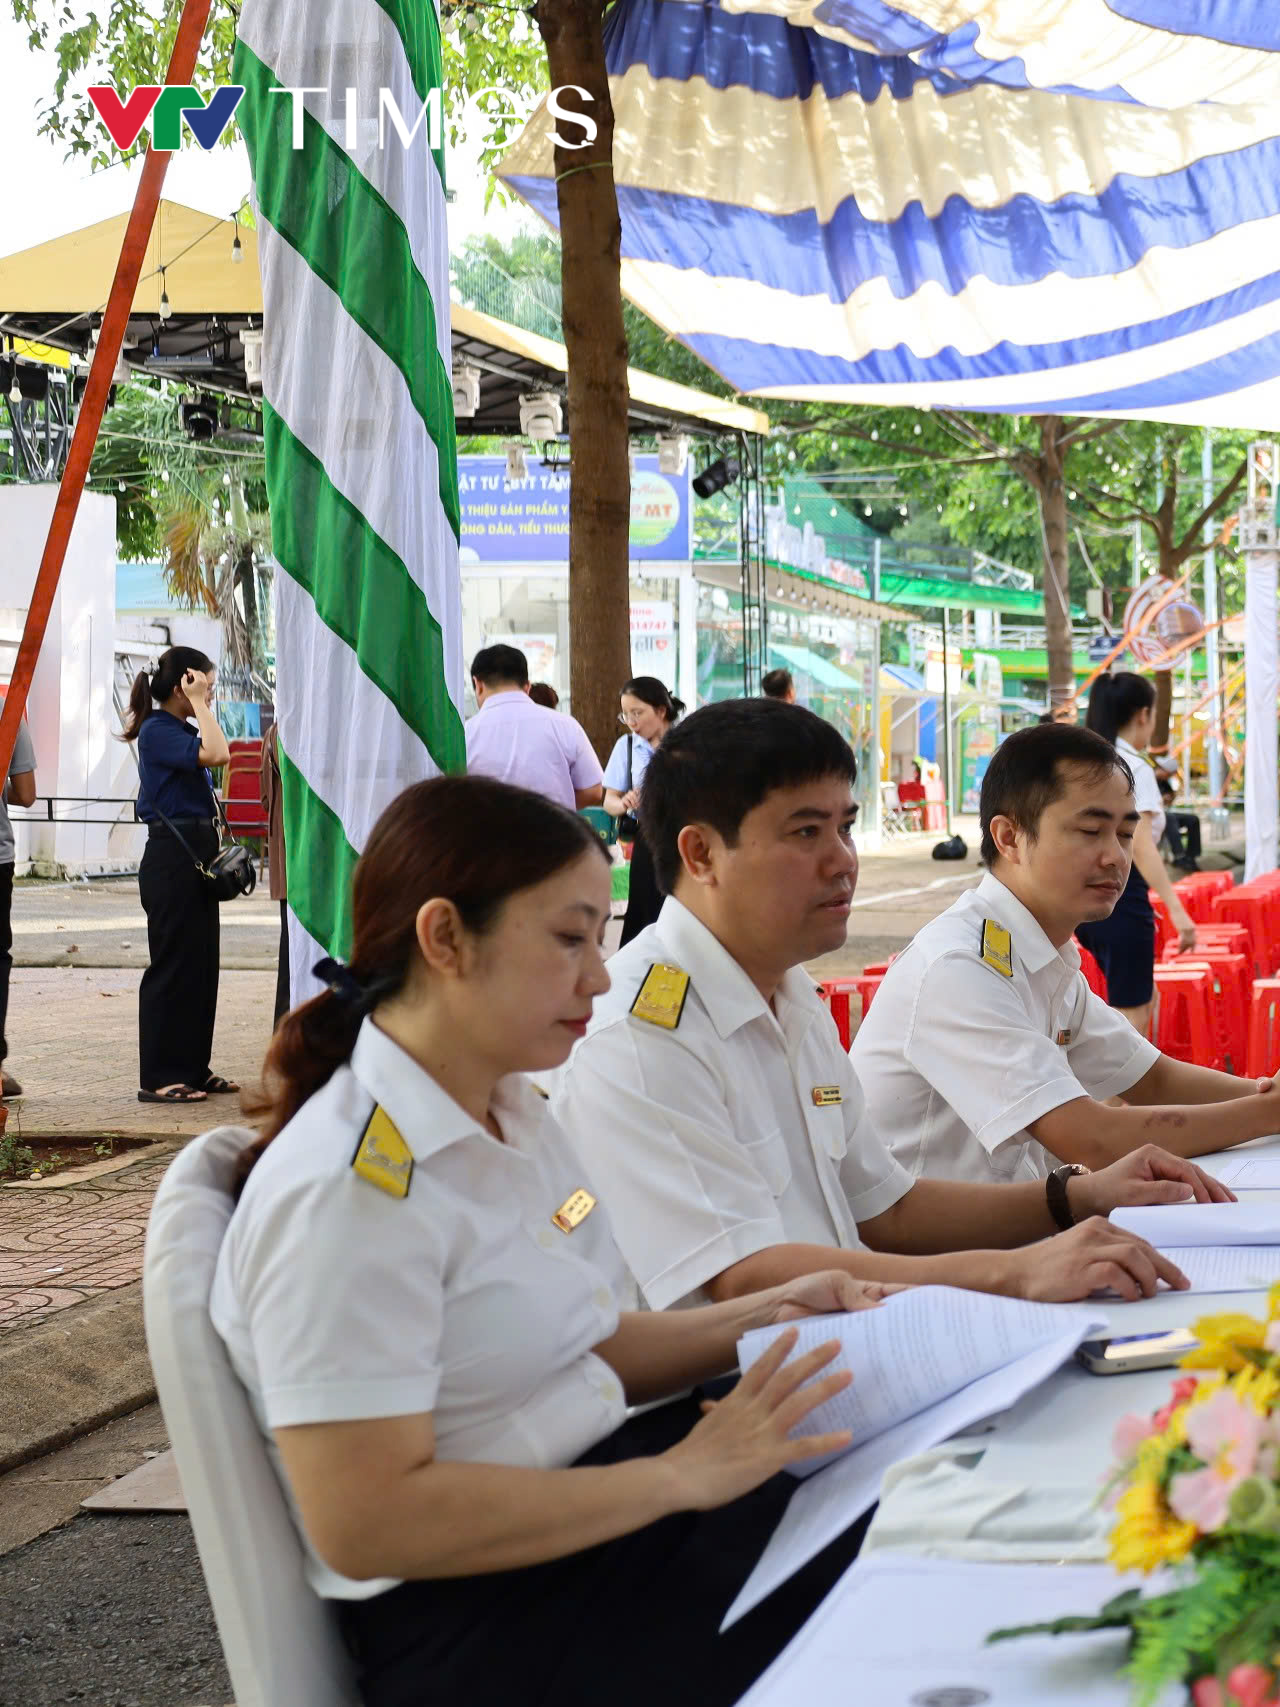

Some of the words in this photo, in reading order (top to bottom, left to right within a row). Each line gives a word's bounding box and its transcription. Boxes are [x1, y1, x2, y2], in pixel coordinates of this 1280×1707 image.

[458, 472, 477, 494] ẬT
[480, 474, 499, 490] TƯ
[468, 502, 497, 517] THIỆU
[501, 501, 522, 515] SẢN
[525, 500, 558, 516] PHẨM
[460, 522, 485, 534] ÔNG
